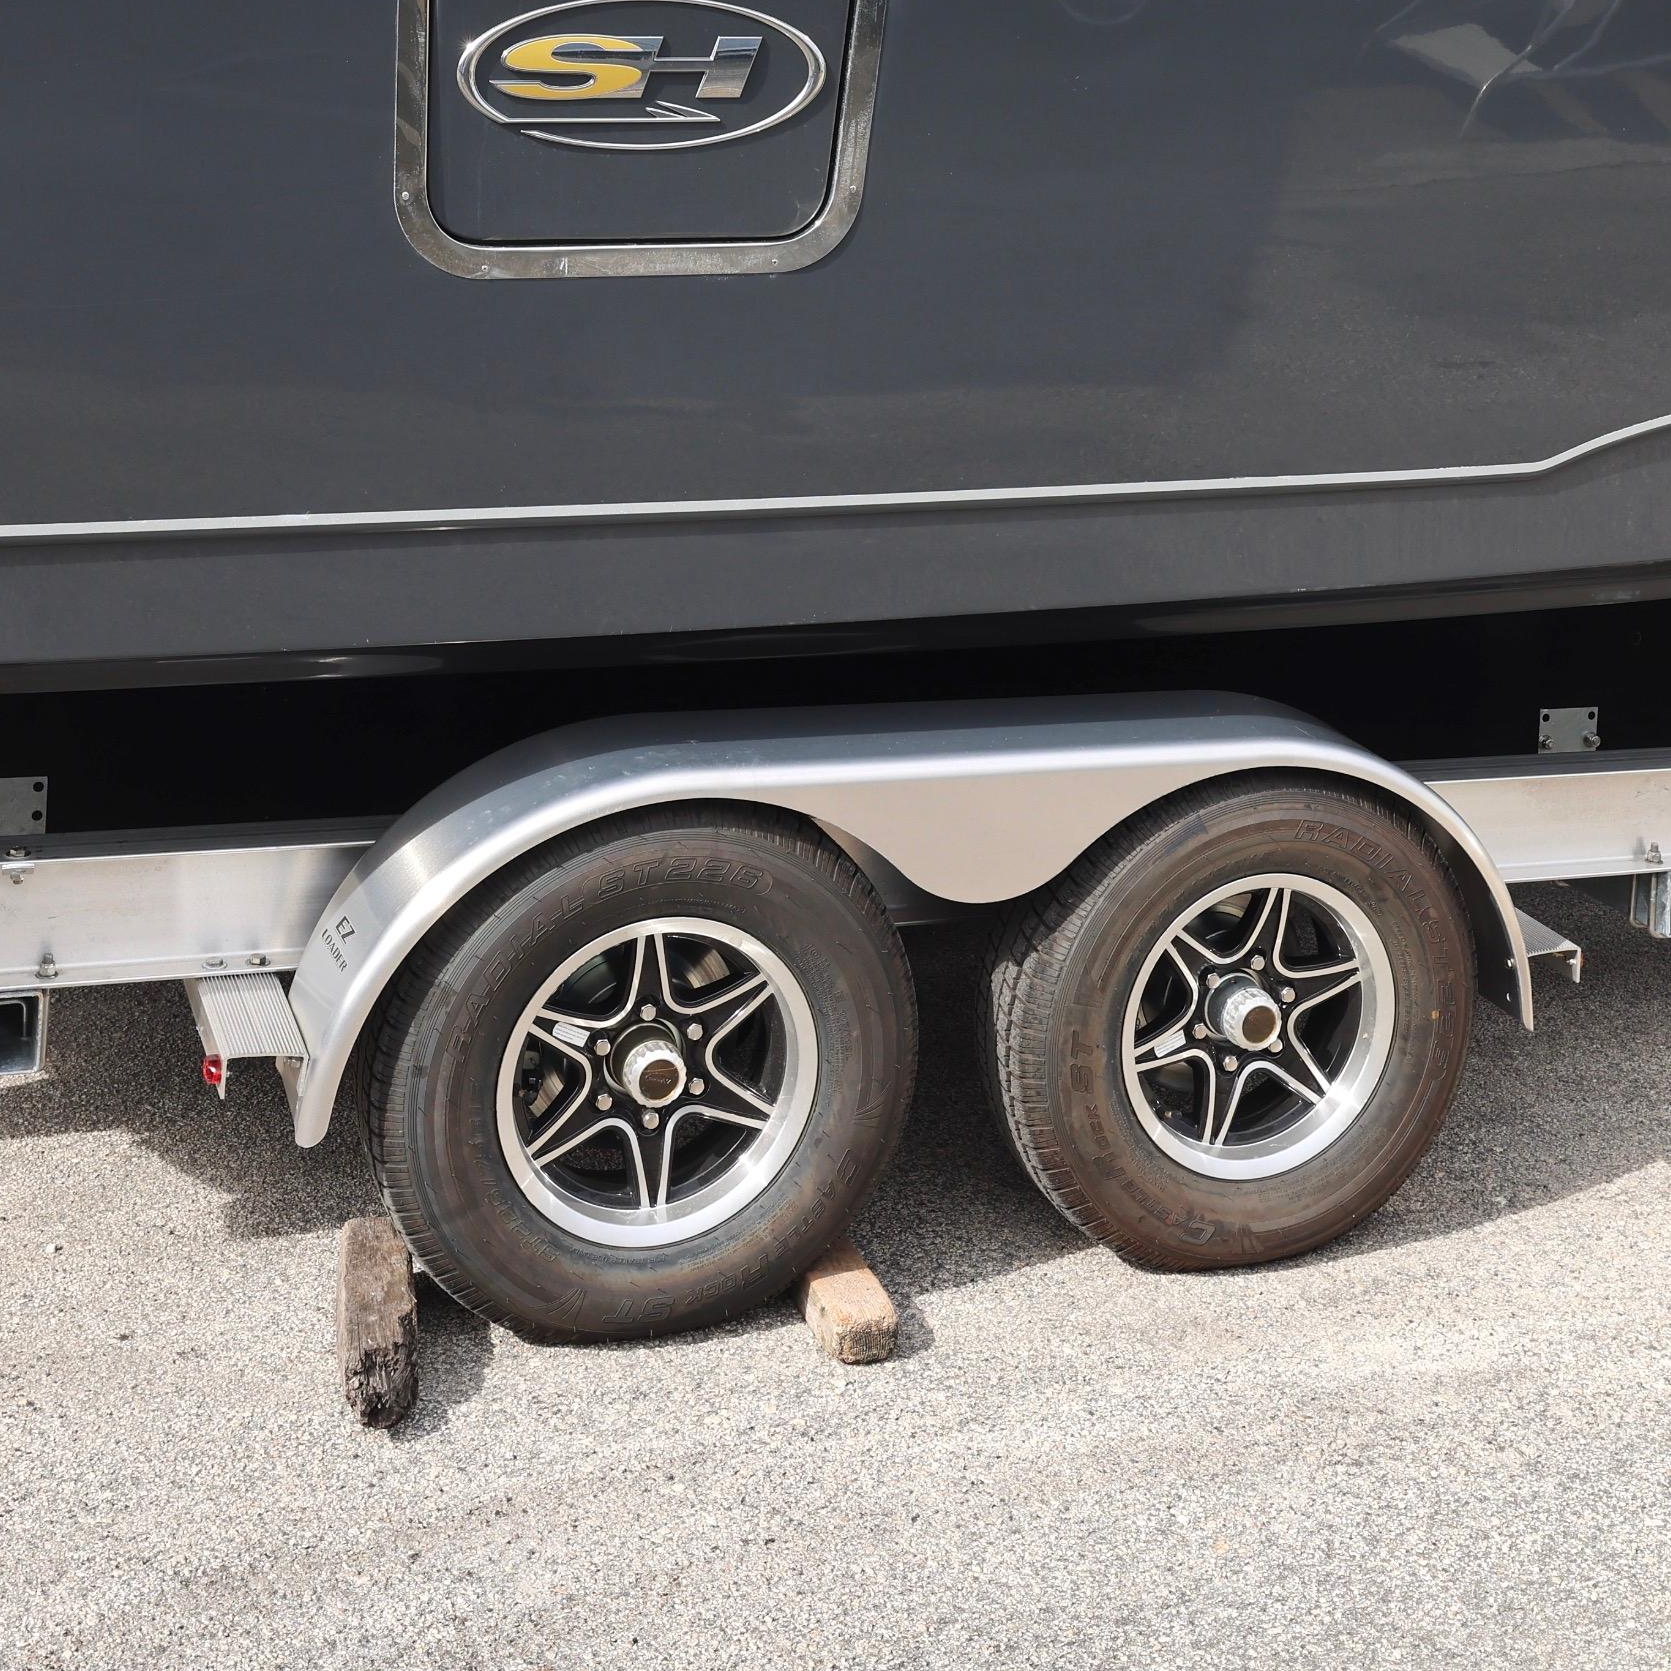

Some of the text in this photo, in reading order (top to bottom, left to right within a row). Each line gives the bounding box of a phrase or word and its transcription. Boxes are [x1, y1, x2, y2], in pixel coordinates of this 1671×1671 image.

[489, 33, 763, 101] SH
[321, 928, 348, 973] LOADER
[336, 915, 356, 945] EZ
